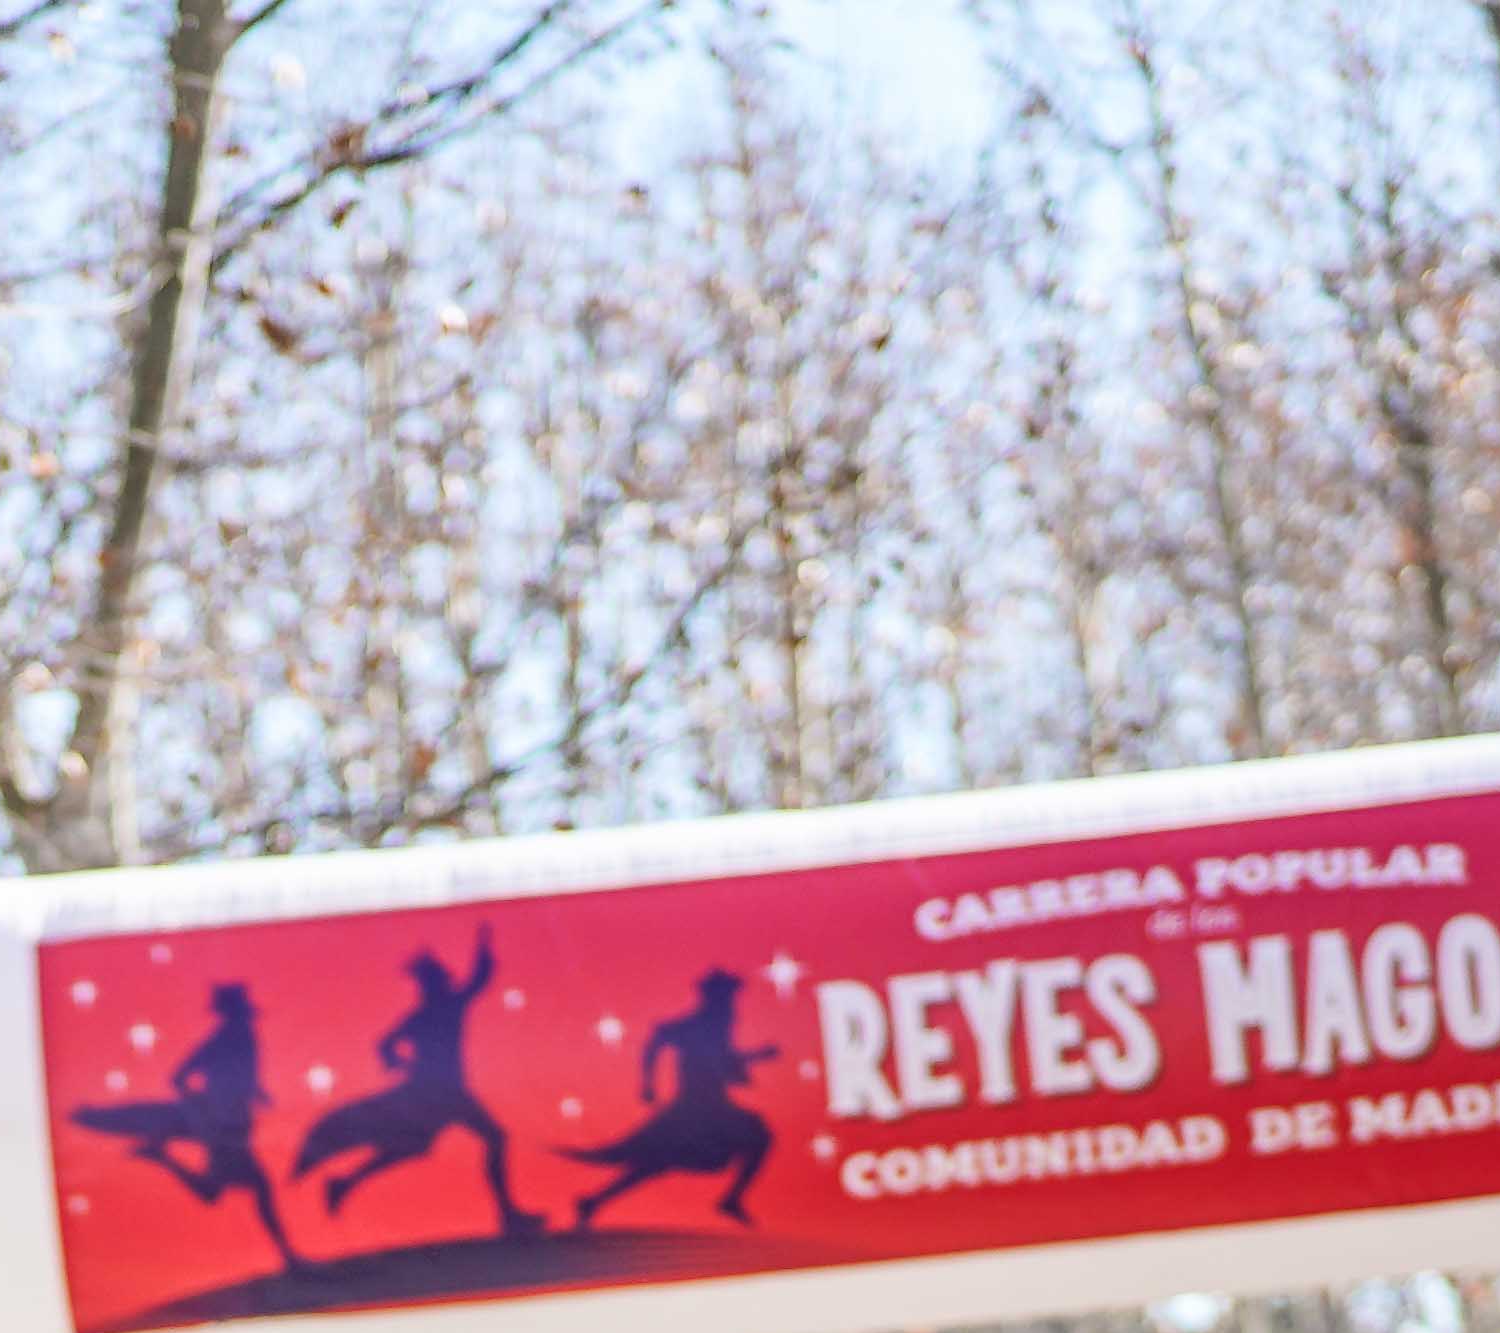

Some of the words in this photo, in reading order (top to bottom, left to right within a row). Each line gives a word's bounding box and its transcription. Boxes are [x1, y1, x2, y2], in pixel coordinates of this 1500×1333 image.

[913, 865, 1187, 941] CARRERA
[1195, 842, 1468, 897] POPULAR
[816, 954, 1163, 1121] REYES
[840, 1114, 1230, 1199] COMUNIDAD
[1248, 1102, 1338, 1156] DE
